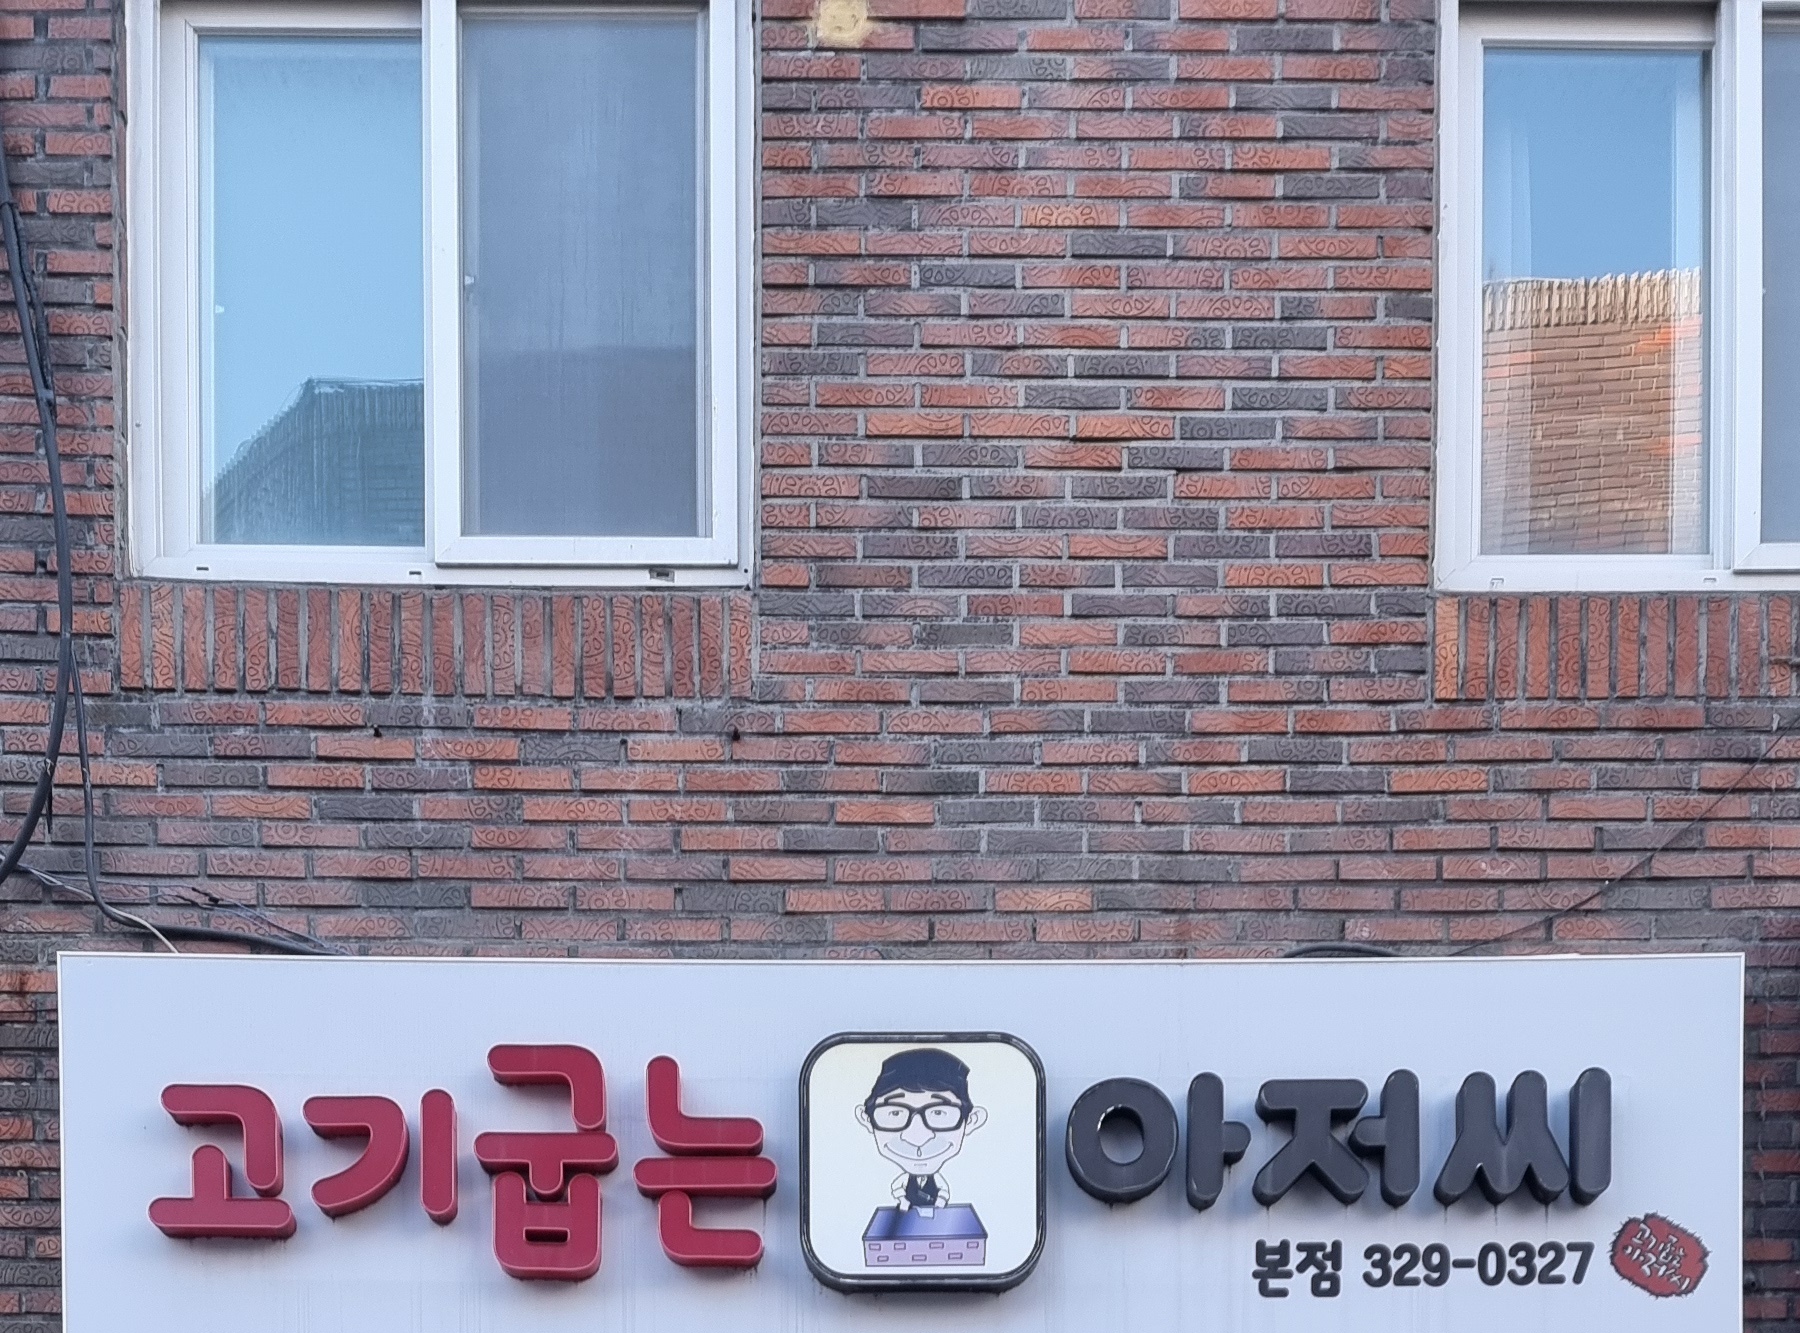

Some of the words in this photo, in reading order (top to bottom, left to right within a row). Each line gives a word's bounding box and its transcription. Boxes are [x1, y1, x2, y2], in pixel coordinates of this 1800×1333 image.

[148, 1042, 778, 1281] 고기굽는
[1065, 1067, 1613, 1211] 아저씨
[1252, 1238, 1343, 1298] 본점
[1362, 1241, 1596, 1288] 329-0327
